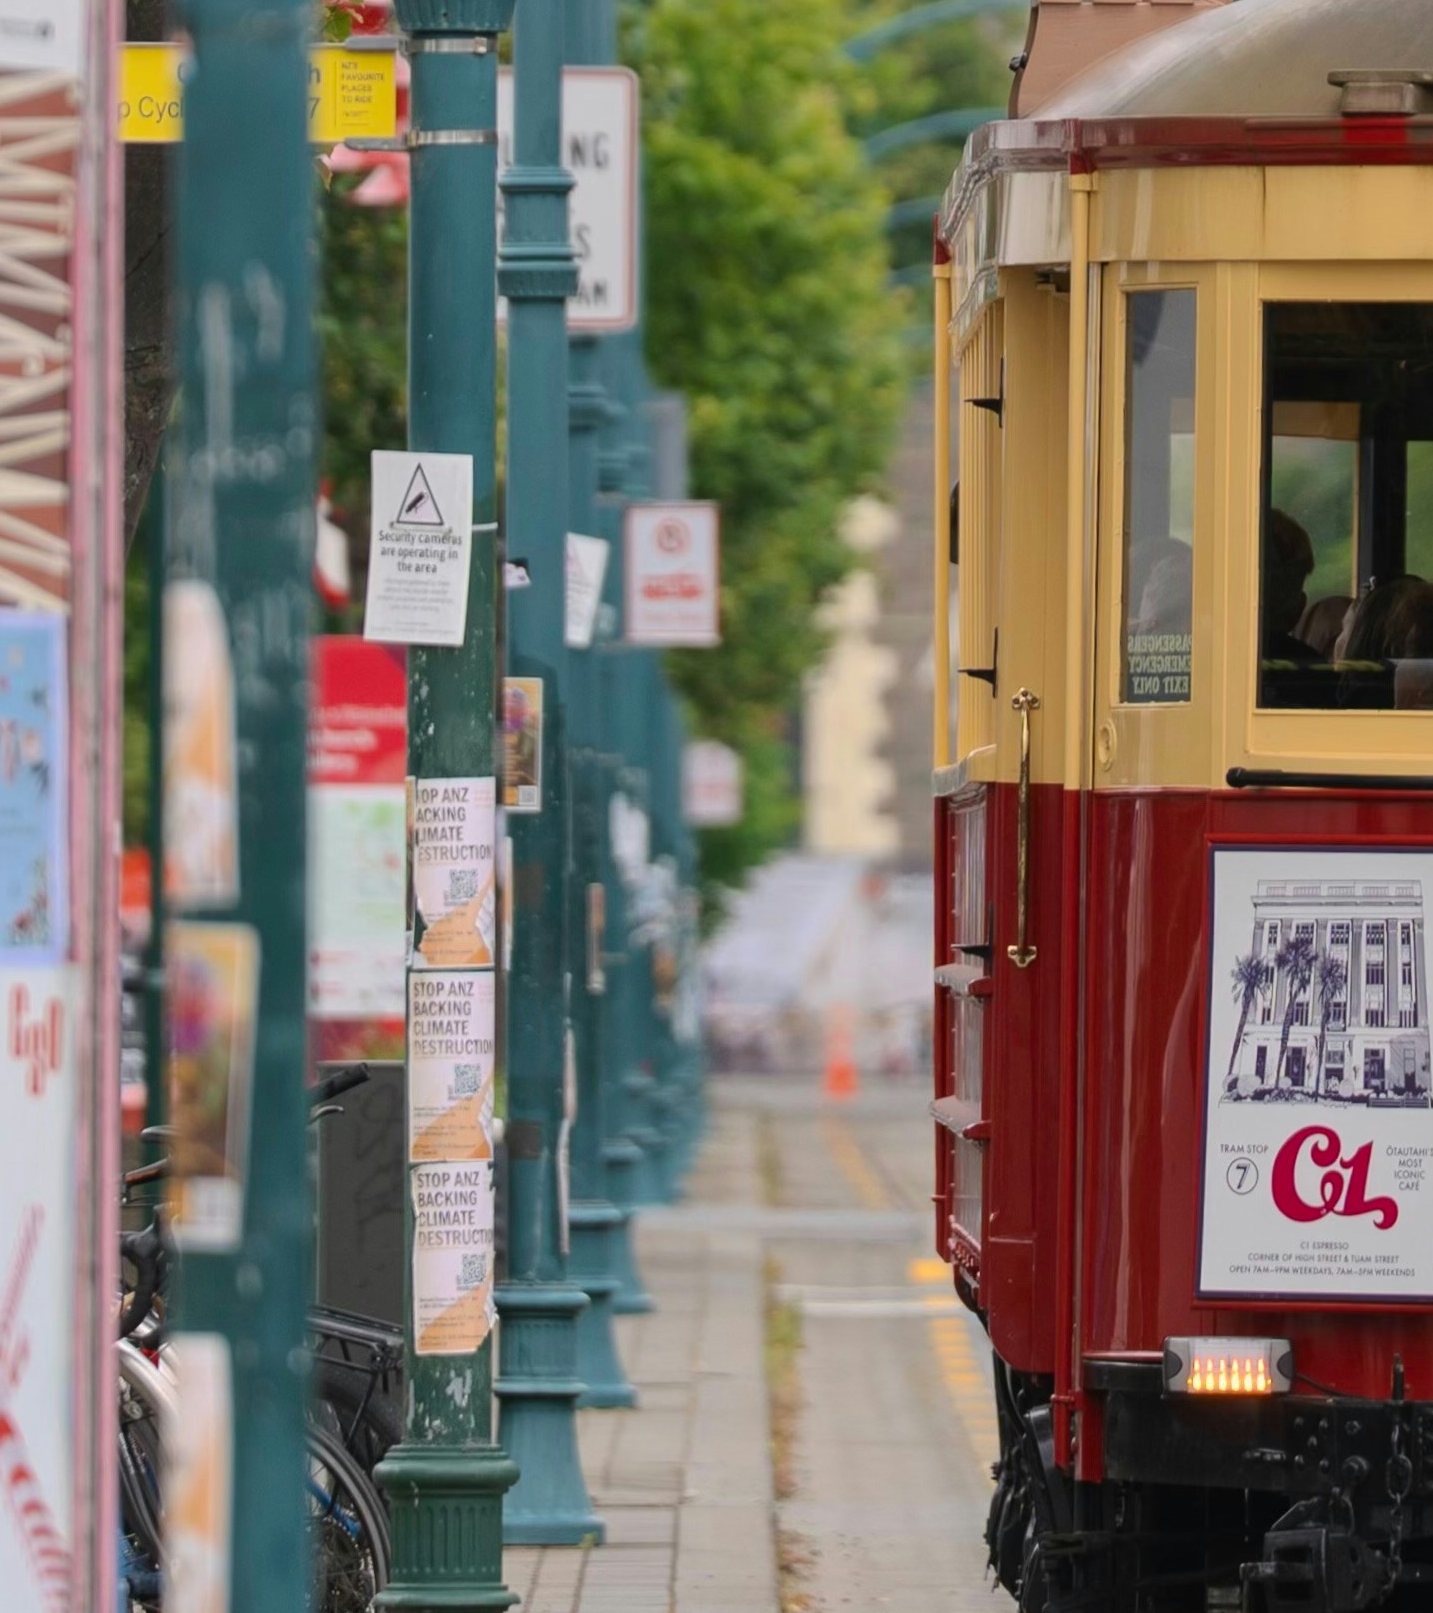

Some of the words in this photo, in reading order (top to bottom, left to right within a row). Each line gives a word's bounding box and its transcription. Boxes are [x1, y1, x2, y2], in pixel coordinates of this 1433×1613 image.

[342, 84, 372, 92] PLACES
[343, 95, 352, 103] TO
[355, 95, 373, 103] RIDE
[379, 530, 415, 545] Security
[418, 532, 462, 546] cameras
[380, 546, 395, 556] are
[398, 546, 446, 562] operating
[448, 547, 458, 560] in
[397, 560, 412, 573] the
[415, 562, 437, 574] area
[417, 787, 439, 803] OP
[441, 787, 469, 803] ANZ
[417, 806, 466, 823] ACKING
[417, 826, 464, 843] LIMATE
[417, 844, 492, 862] ESTRUCTION
[413, 981, 445, 997] STOP
[448, 981, 474, 997] ANZ
[413, 1001, 472, 1017] BACKING
[413, 1020, 469, 1036] CLIMATE
[1220, 1144, 1246, 1153] TRAM
[1247, 1144, 1269, 1154] STOP
[1398, 1158, 1423, 1168] MOST
[417, 1171, 451, 1188] STOP
[454, 1170, 480, 1187] ANZ
[1235, 1163, 1250, 1190] 7
[1394, 1170, 1425, 1180] ICONIC
[1399, 1179, 1420, 1191] CAFÉ
[417, 1190, 478, 1208] BACKING
[418, 1209, 476, 1227] CLIMATE
[1312, 1241, 1349, 1250] ESPRESSO
[1248, 1253, 1279, 1261] CORNER
[1282, 1253, 1293, 1262] OF
[1295, 1254, 1315, 1262] HIGH
[1317, 1254, 1342, 1262] STREET
[1344, 1254, 1349, 1262] &
[1351, 1255, 1372, 1263] TUAM
[1374, 1255, 1399, 1263] STREET
[1229, 1265, 1250, 1273] OPEN
[1292, 1267, 1334, 1276] WEEKDAYS,
[1374, 1268, 1416, 1277] WEEKENDS
